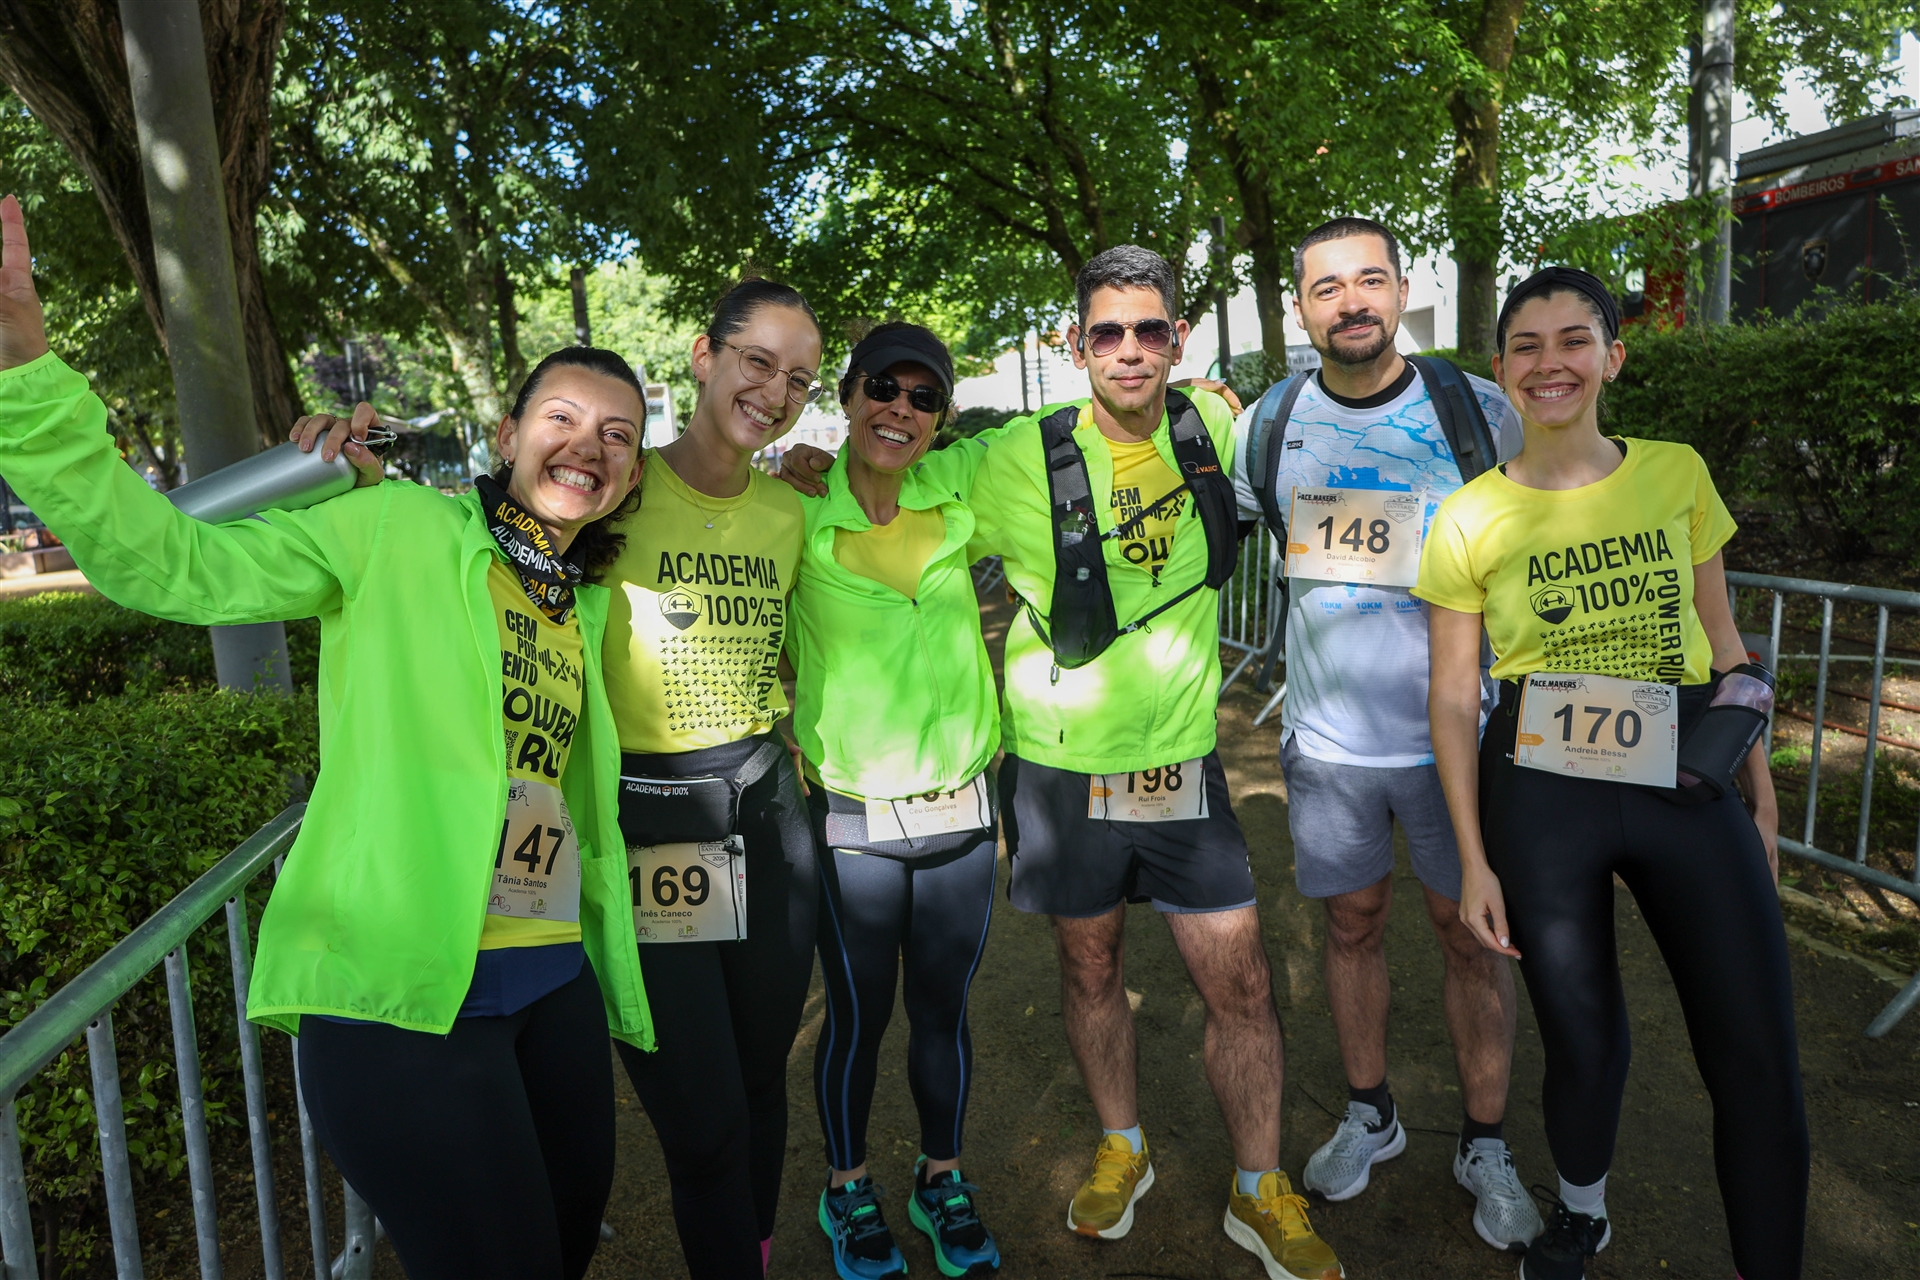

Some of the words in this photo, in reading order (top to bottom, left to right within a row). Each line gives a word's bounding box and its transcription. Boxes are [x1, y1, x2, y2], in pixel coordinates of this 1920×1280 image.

[1774, 176, 1846, 204] BOMBEIROS
[1111, 487, 1142, 508] CEM
[496, 501, 553, 557] ACADEMIA
[1317, 516, 1390, 554] 148
[491, 525, 552, 573] ACADEMIA
[1528, 529, 1673, 587] ACADEMIA
[657, 551, 780, 591] ACADEMIA
[1320, 601, 1342, 609] 18KM
[1395, 599, 1422, 608] 10KM
[1576, 572, 1655, 614] 100%
[1653, 569, 1681, 651] POWER
[505, 609, 537, 643] CEM
[704, 594, 769, 628] 100%
[516, 636, 537, 662] POR
[758, 598, 783, 679] POWER
[501, 650, 538, 686] ENTO
[1554, 703, 1642, 748] 170
[1564, 745, 1598, 754] Andreia
[1601, 749, 1627, 758] Bessa
[1729, 747, 1747, 774] KIPRUN
[626, 782, 661, 795] ACADEMIA
[672, 786, 689, 795] 100%
[1121, 763, 1182, 793] 198
[924, 803, 957, 813] Gonçalves
[495, 819, 565, 875] 147
[497, 873, 521, 885] Tânia
[523, 877, 548, 888] Santos
[628, 865, 710, 907] 169
